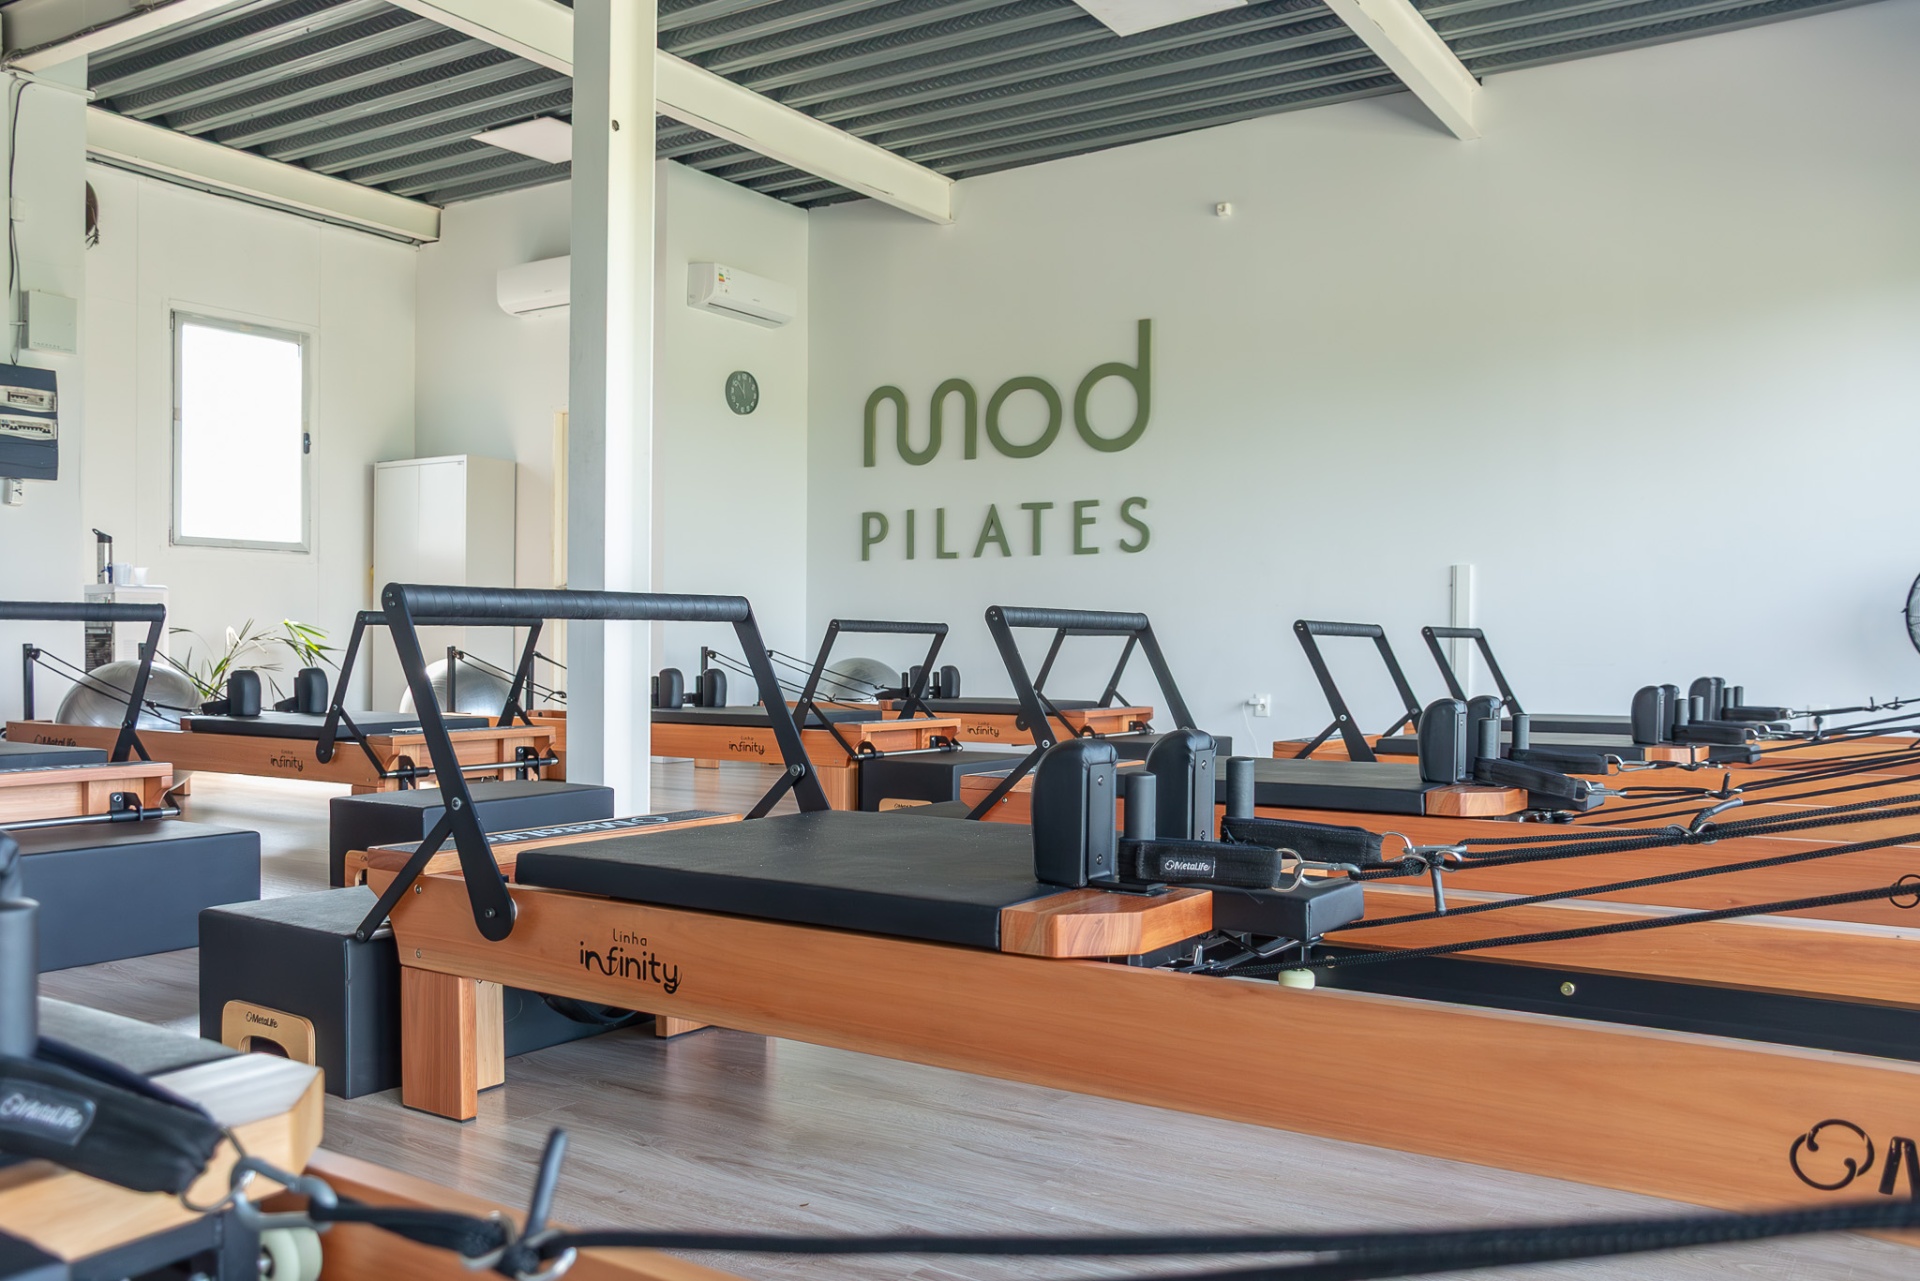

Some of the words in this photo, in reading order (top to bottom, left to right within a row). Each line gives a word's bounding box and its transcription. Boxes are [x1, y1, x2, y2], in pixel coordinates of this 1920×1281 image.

[863, 318, 1151, 467] mod
[861, 496, 1151, 561] PILATES
[270, 754, 304, 772] infinity
[728, 740, 766, 756] infinity
[1174, 860, 1211, 871] MetaLife
[579, 940, 683, 994] infinity
